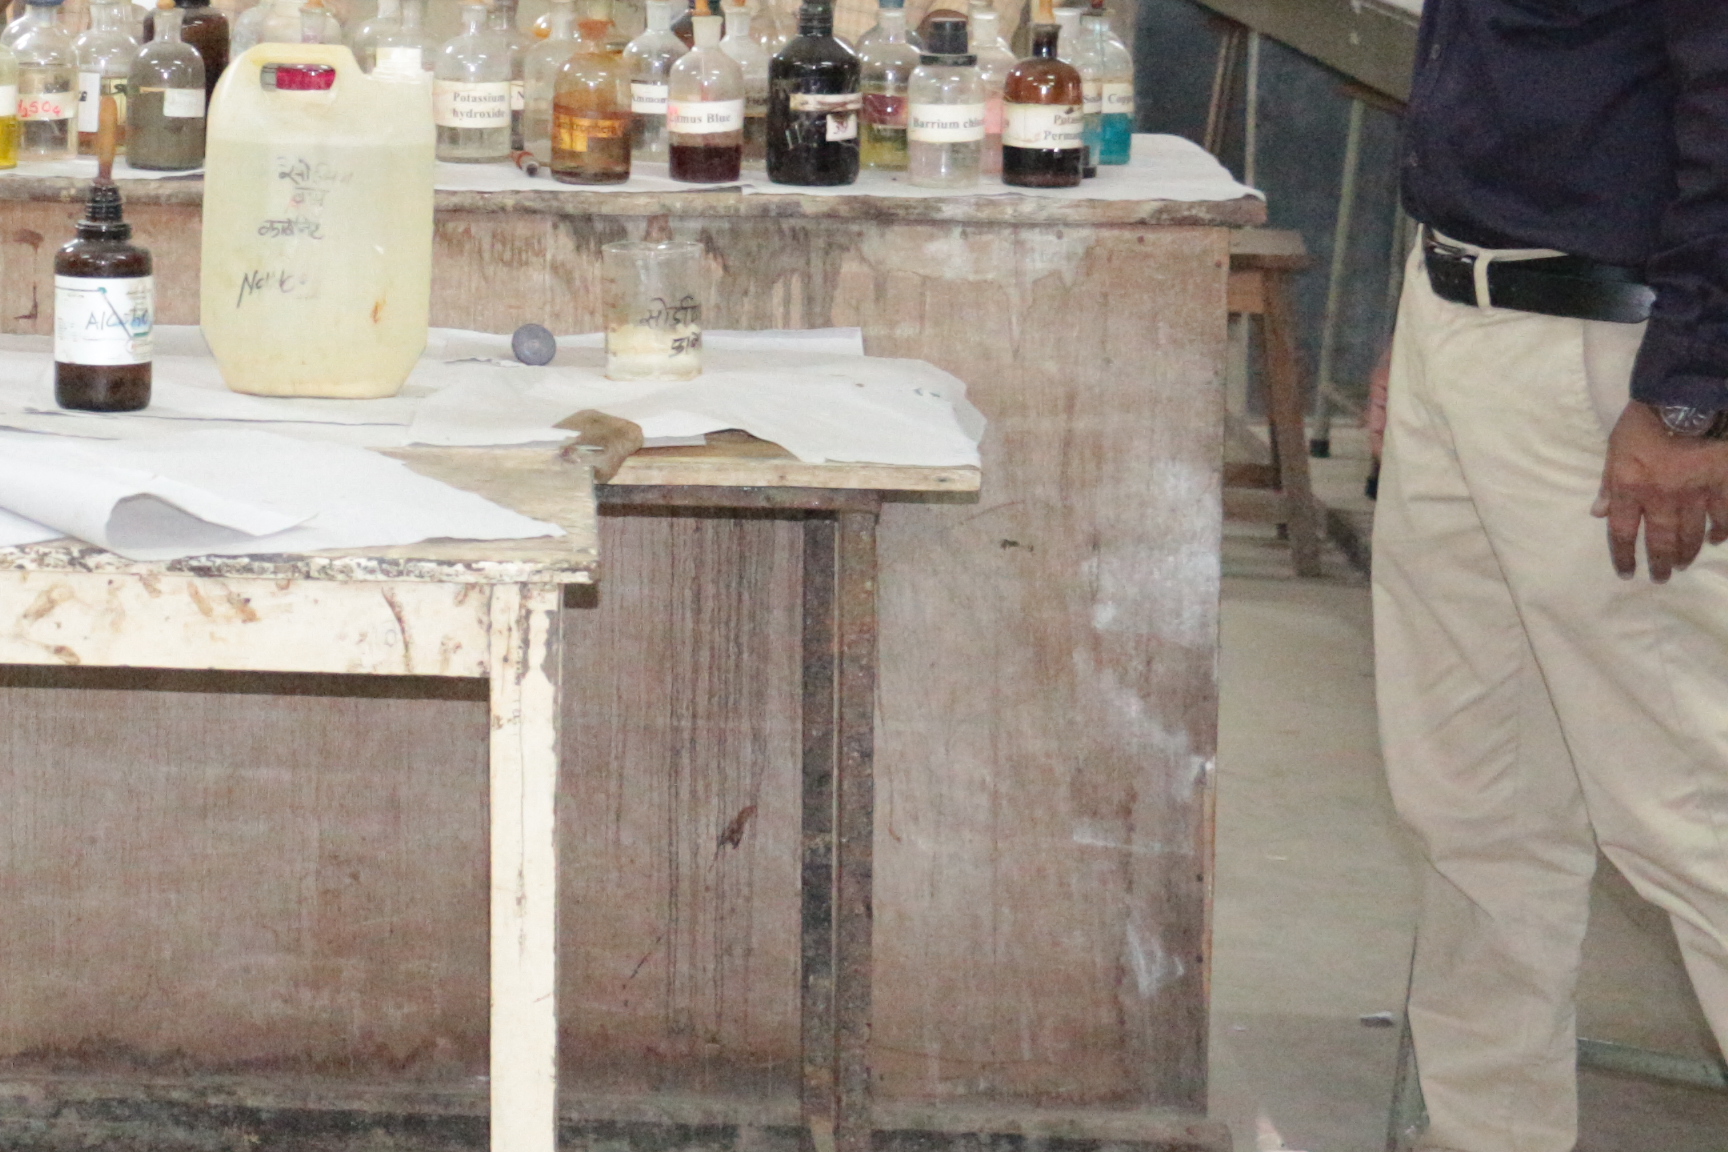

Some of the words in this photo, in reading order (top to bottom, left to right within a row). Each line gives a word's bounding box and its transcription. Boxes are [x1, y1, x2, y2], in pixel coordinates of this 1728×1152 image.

[452, 91, 506, 104] Potassium
[452, 109, 506, 121] hydroxide
[707, 112, 731, 124] Blue
[912, 117, 960, 129] Barrium
